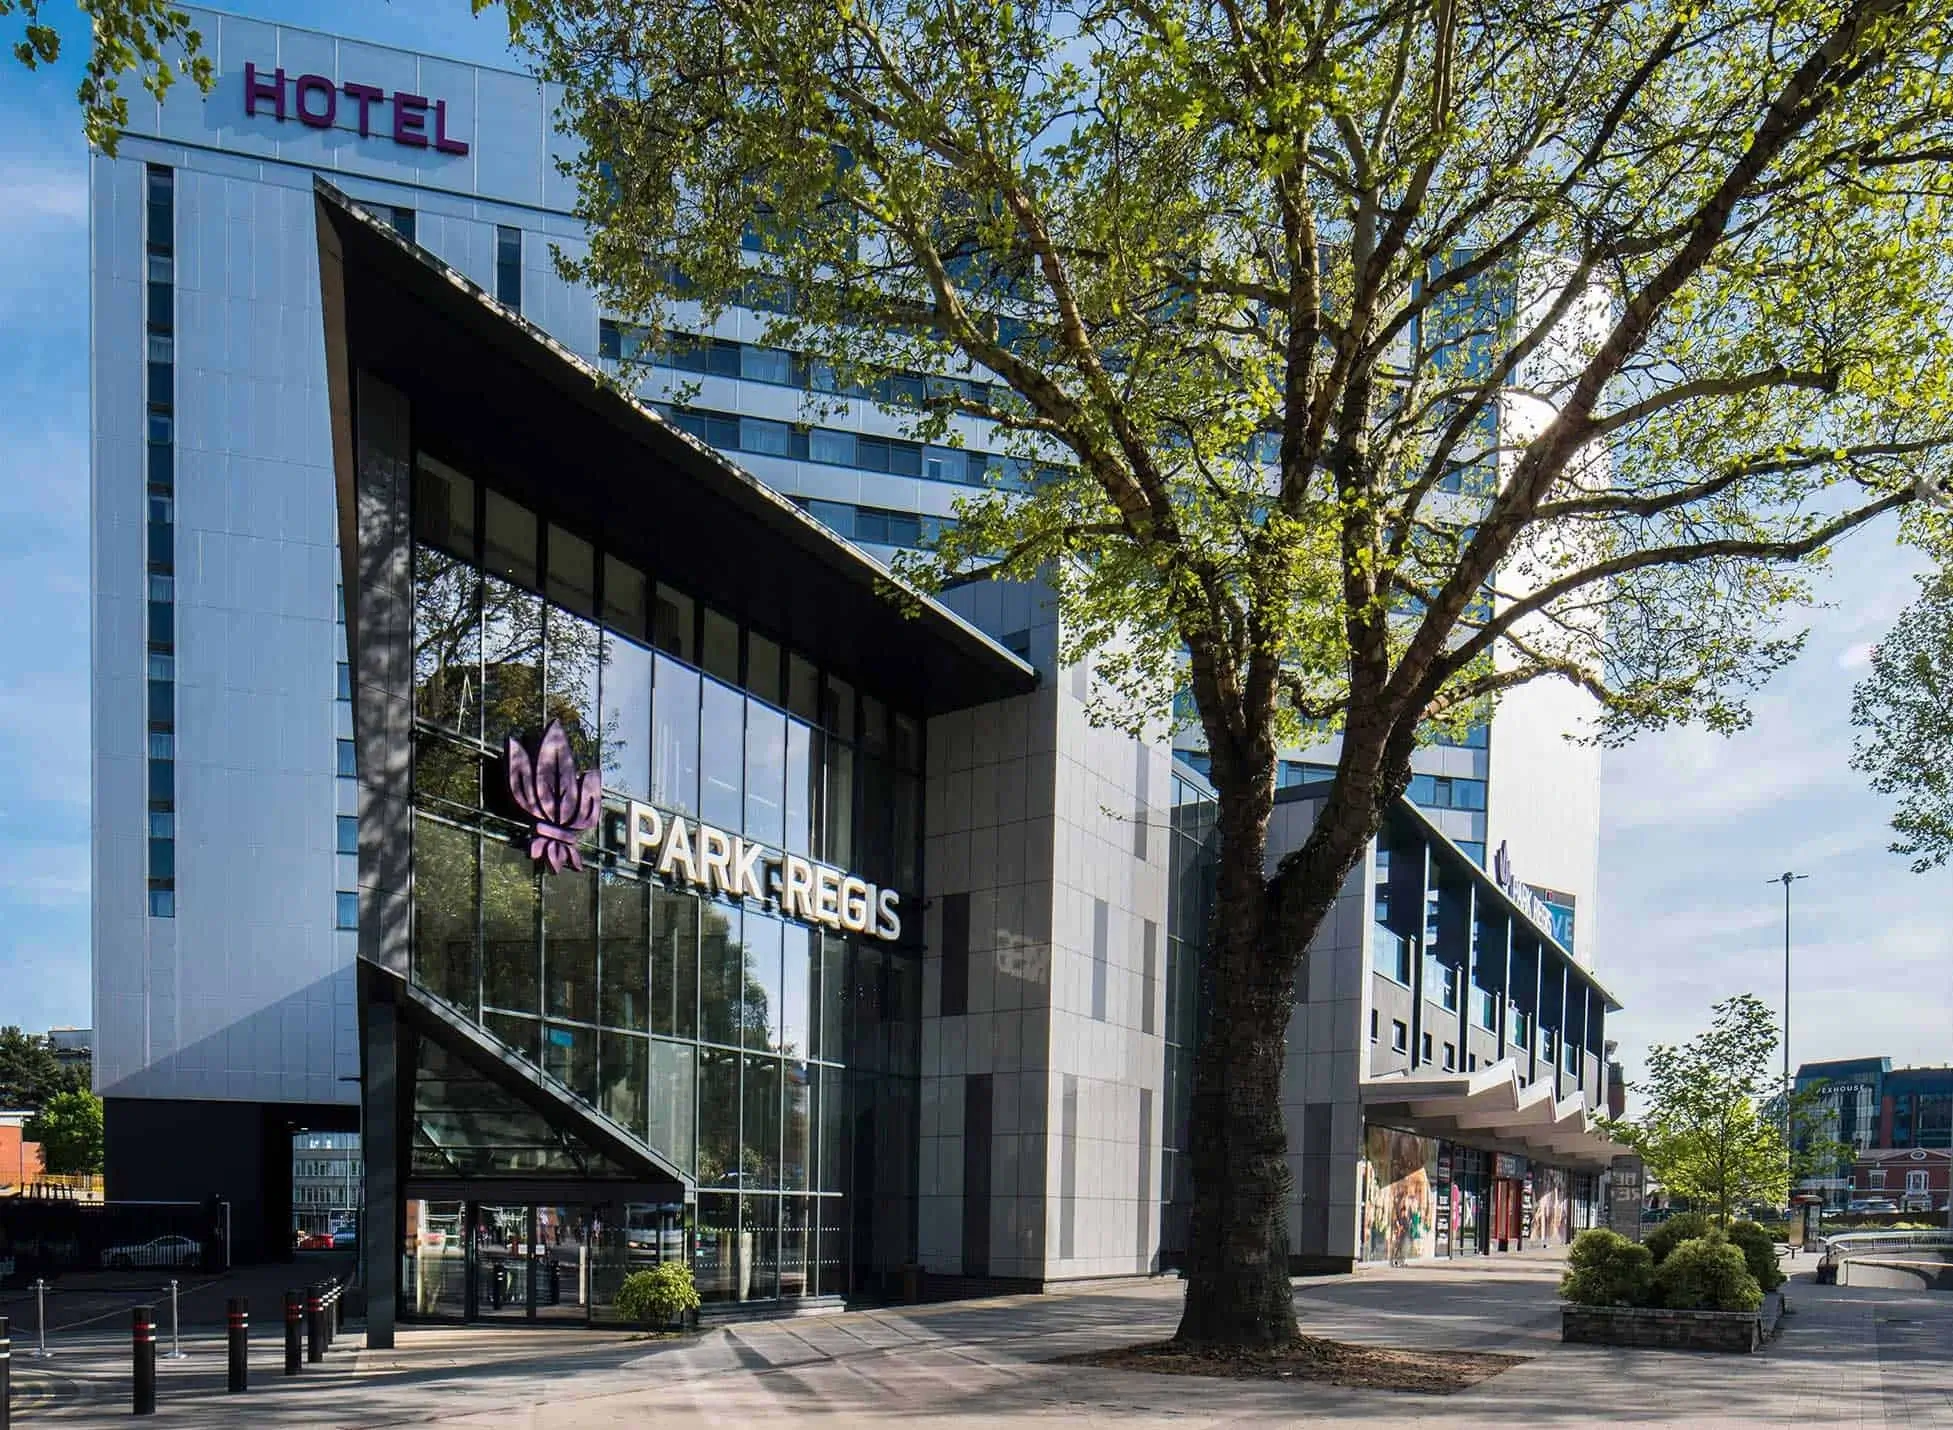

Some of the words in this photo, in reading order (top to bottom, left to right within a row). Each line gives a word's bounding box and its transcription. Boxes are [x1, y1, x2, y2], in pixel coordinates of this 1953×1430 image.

[245, 62, 469, 156] HOTEL
[625, 799, 765, 901] PARK
[782, 854, 901, 941] REGIS
